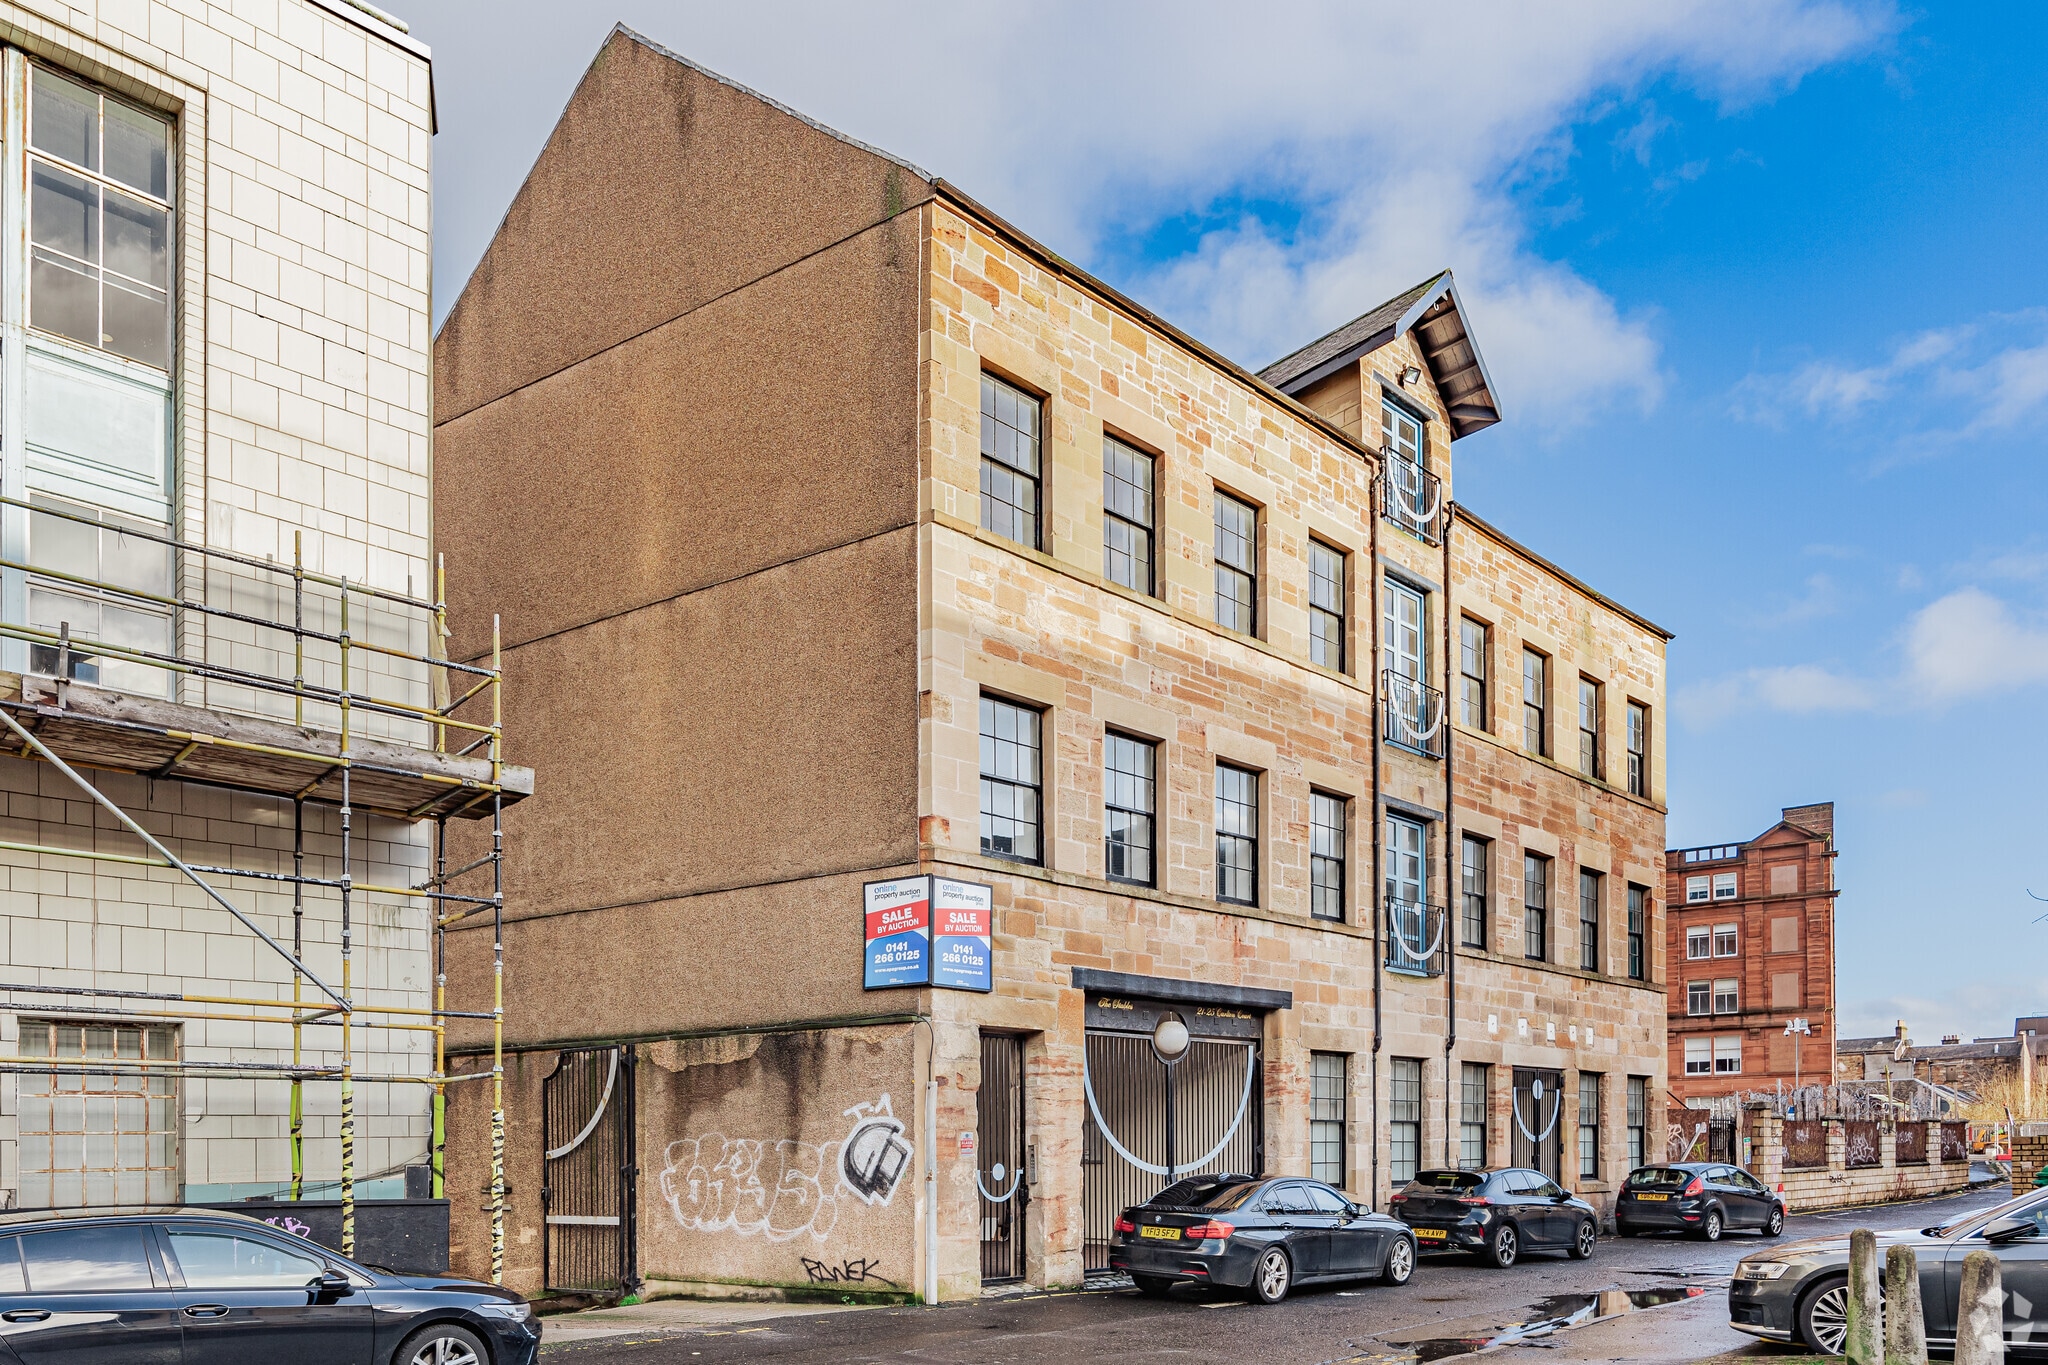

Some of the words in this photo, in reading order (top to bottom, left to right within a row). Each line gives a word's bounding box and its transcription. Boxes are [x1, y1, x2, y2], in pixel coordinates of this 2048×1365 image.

[874, 884, 897, 894] online
[942, 883, 964, 893] online
[874, 891, 899, 901] property
[899, 888, 921, 897] auction
[942, 891, 965, 901] property
[965, 894, 984, 902] auction
[882, 907, 913, 924] SALE
[949, 912, 977, 924] SALE
[877, 925, 887, 934] BY
[888, 918, 919, 931] AUCTION
[944, 924, 954, 932] BY
[955, 924, 983, 933] AUCTION
[885, 941, 908, 953] 0141
[952, 943, 973, 955] 0141
[874, 952, 894, 964] 266
[895, 950, 920, 962] 0125
[942, 952, 961, 963] 266
[962, 954, 984, 966] 0125
[1098, 998, 1111, 1008] The
[1145, 1227, 1160, 1236] YF13
[1161, 1229, 1176, 1238] SFZ
